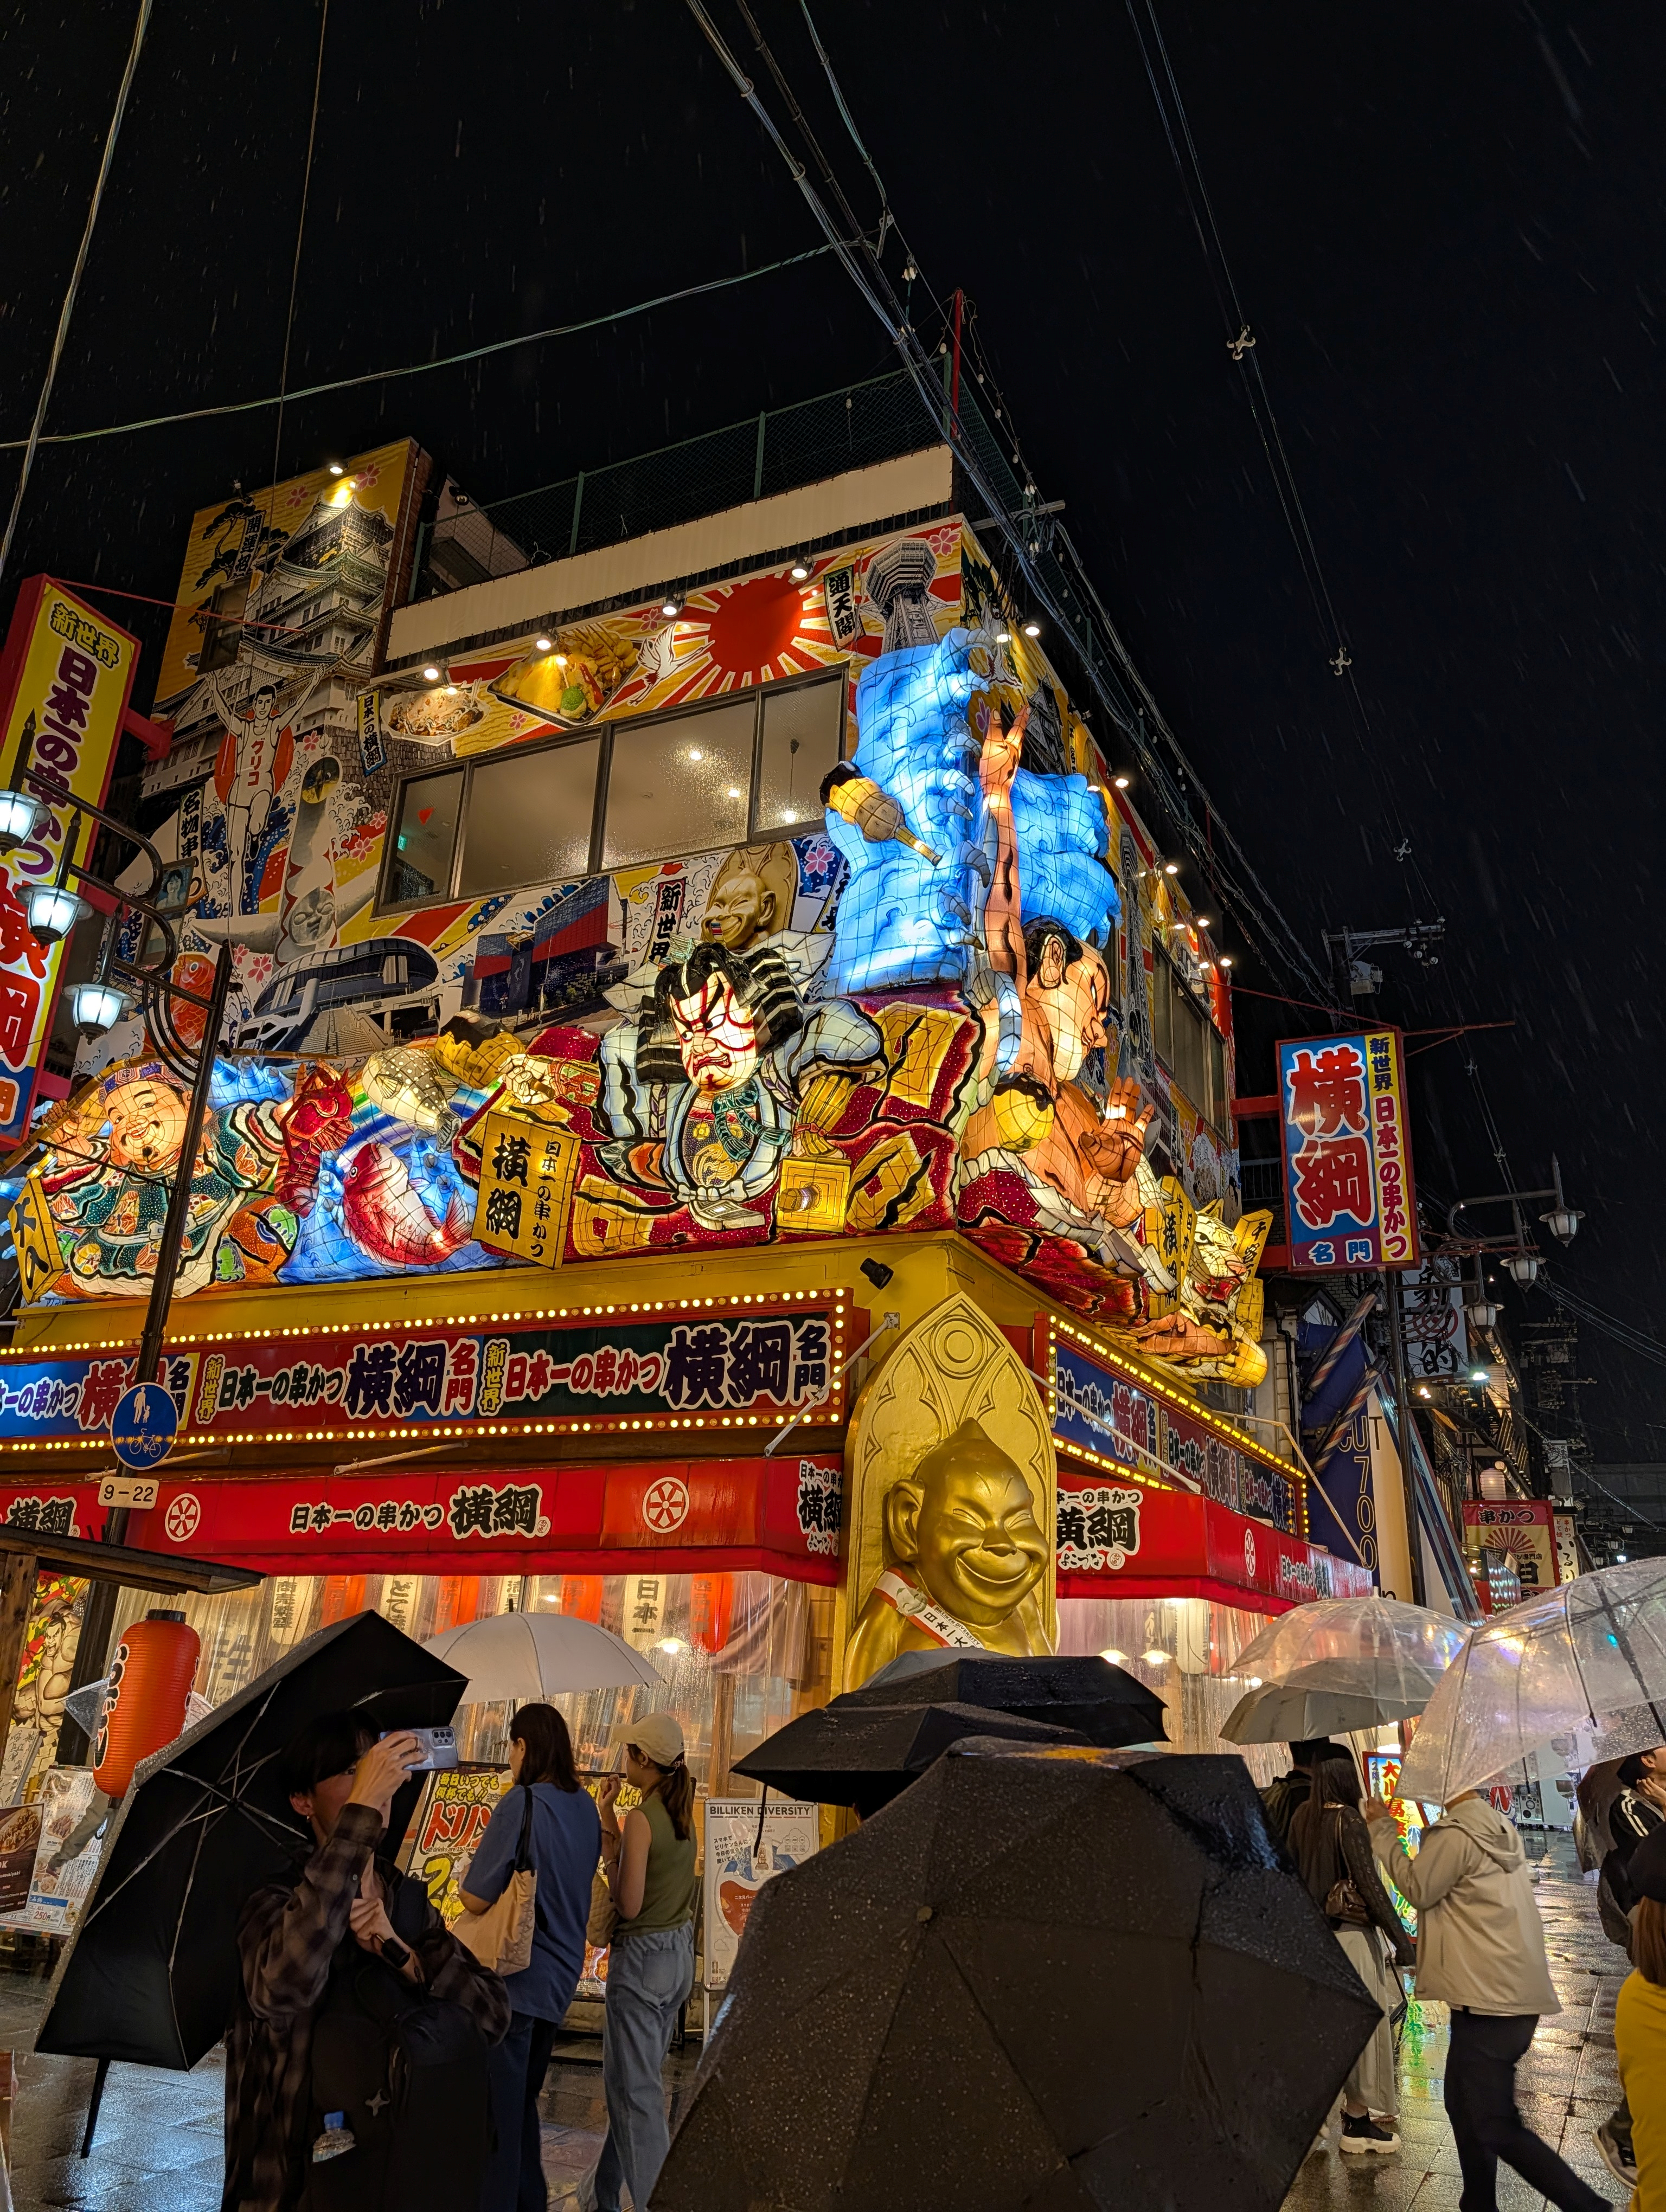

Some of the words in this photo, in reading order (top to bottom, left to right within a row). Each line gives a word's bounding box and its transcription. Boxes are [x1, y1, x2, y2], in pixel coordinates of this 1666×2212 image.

[234, 513, 262, 578] 開運招
[52, 602, 119, 667] 新世界
[828, 571, 856, 639] 通天閣
[249, 736, 265, 786] グリコ
[363, 695, 382, 769] 日本一の横綱
[181, 789, 203, 897] 名物串つ
[1369, 1036, 1394, 1091] 新世界
[1289, 1046, 1372, 1228] 横綱
[485, 1133, 533, 1240] 横綱
[530, 1140, 561, 1258] 日本一の串かつ
[1375, 1097, 1408, 1259] 日本一の串かつ
[1312, 1240, 1372, 1263] 名門
[199, 1356, 225, 1423] 新世界
[218, 1362, 344, 1410] 日本一の串かつ
[343, 1342, 447, 1416] 横綱
[445, 1342, 477, 1412] 名門
[480, 1343, 506, 1412] 新世界
[505, 1350, 662, 1399] 日本一の串かつ
[663, 1326, 792, 1408] 横綱
[793, 1324, 828, 1402] 名門
[0, 1380, 79, 1419] 一の串かつ
[10, 1500, 75, 1536] 横綱
[293, 1504, 442, 1531] 日本一の串かつ
[451, 1487, 539, 1535] 横綱
[1479, 1509, 1535, 1525] 串かつ
[1060, 1554, 1104, 1567] よこづな
[273, 1581, 297, 1628] 商売繁盛
[632, 1579, 659, 1634] 日本一
[934, 1606, 956, 1626] BILLIKEN
[955, 1623, 981, 1645] DIVERSITY
[440, 1772, 499, 1790] 毎日いつでも
[710, 1806, 754, 1815] BILLIKEN
[758, 1806, 810, 1816] DIVERSITY
